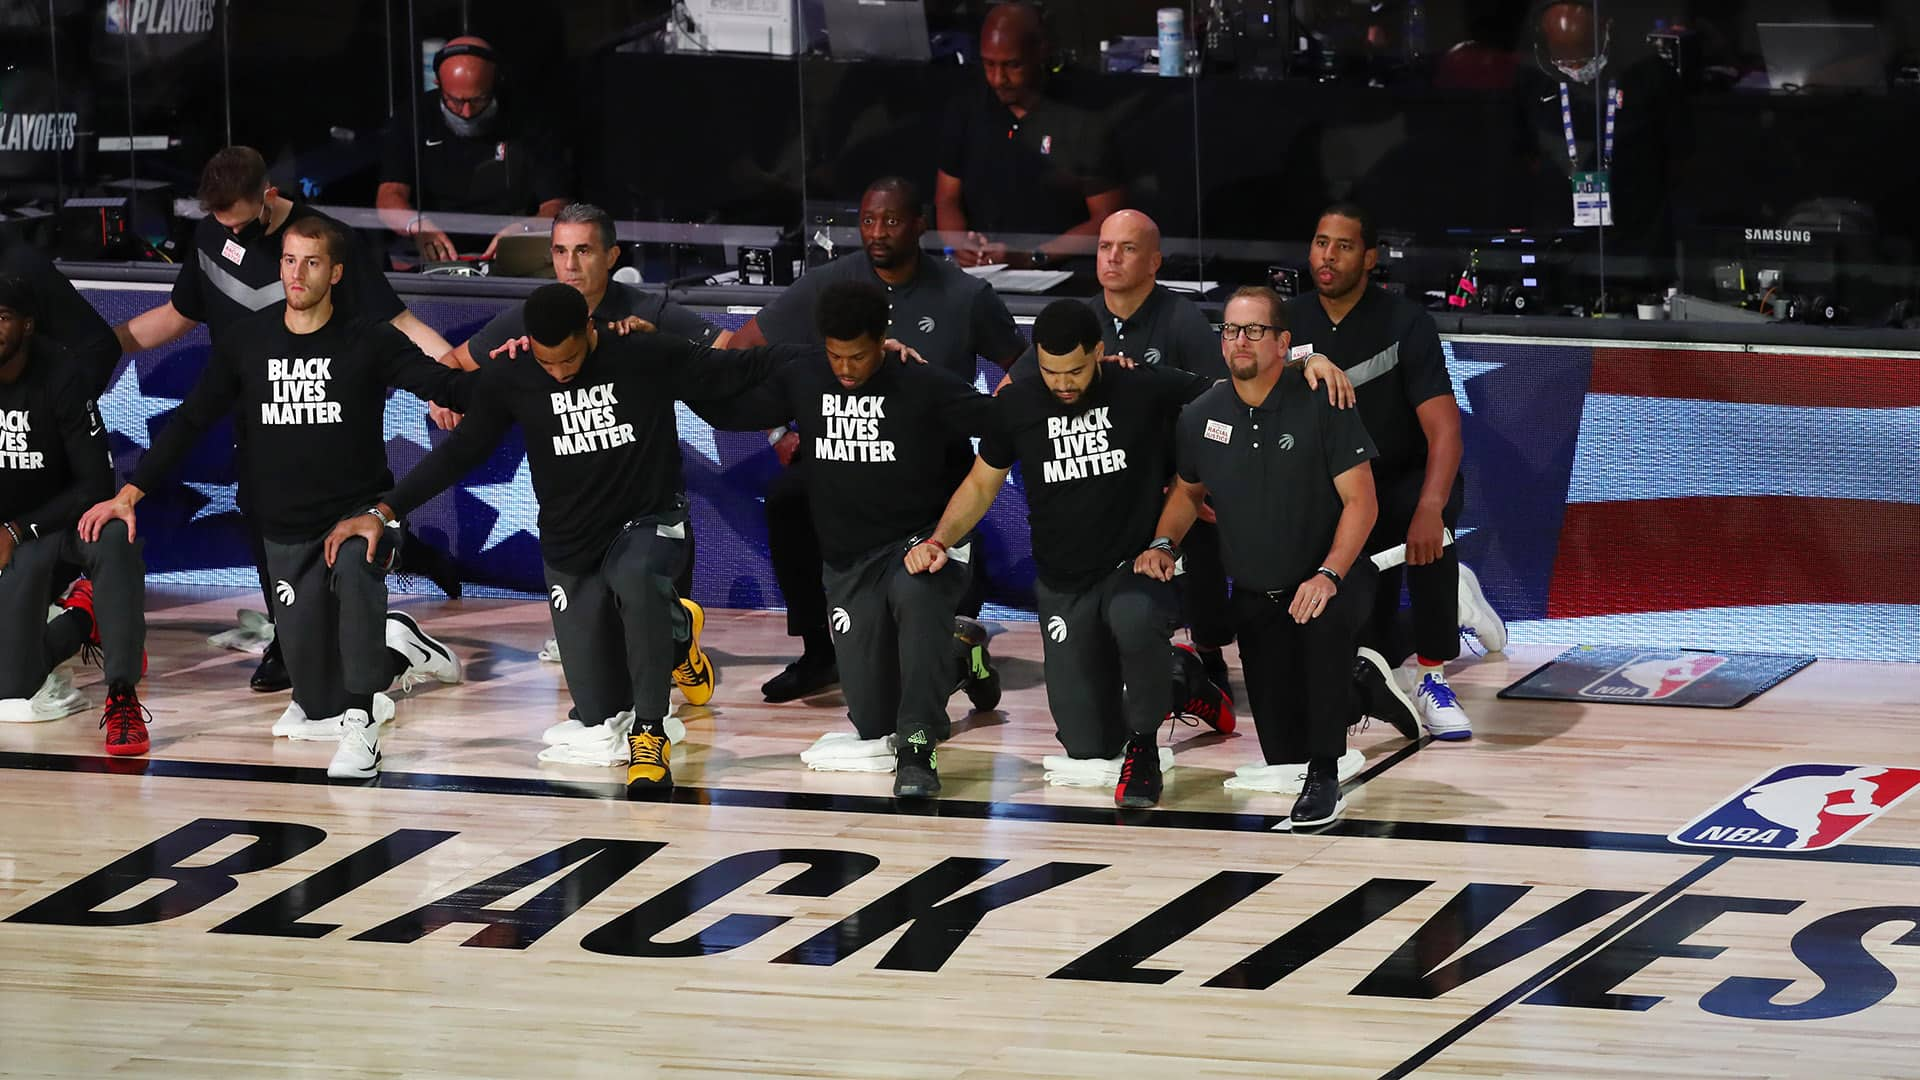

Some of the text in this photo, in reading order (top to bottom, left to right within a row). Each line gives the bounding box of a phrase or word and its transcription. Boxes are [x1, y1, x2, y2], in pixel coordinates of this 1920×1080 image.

[0, 113, 77, 151] LAYOFFS
[1745, 228, 1811, 242] SAMSUNG
[268, 358, 332, 381] BLACK
[273, 380, 326, 403] LIVES
[550, 383, 618, 415] BLACK
[262, 402, 343, 425] MATTER
[822, 394, 886, 418] BLACK
[560, 406, 616, 435] LIVES
[826, 417, 880, 440] LIVES
[1047, 406, 1113, 439] BLACK
[552, 423, 637, 456] MATTER
[815, 438, 897, 462] MATTER
[1053, 430, 1109, 460] LIVES
[1043, 449, 1128, 483] MATTER
[1593, 686, 1640, 696] NBA
[1695, 826, 1782, 843] NBA
[3, 818, 1920, 1020] BLACK LIVES
